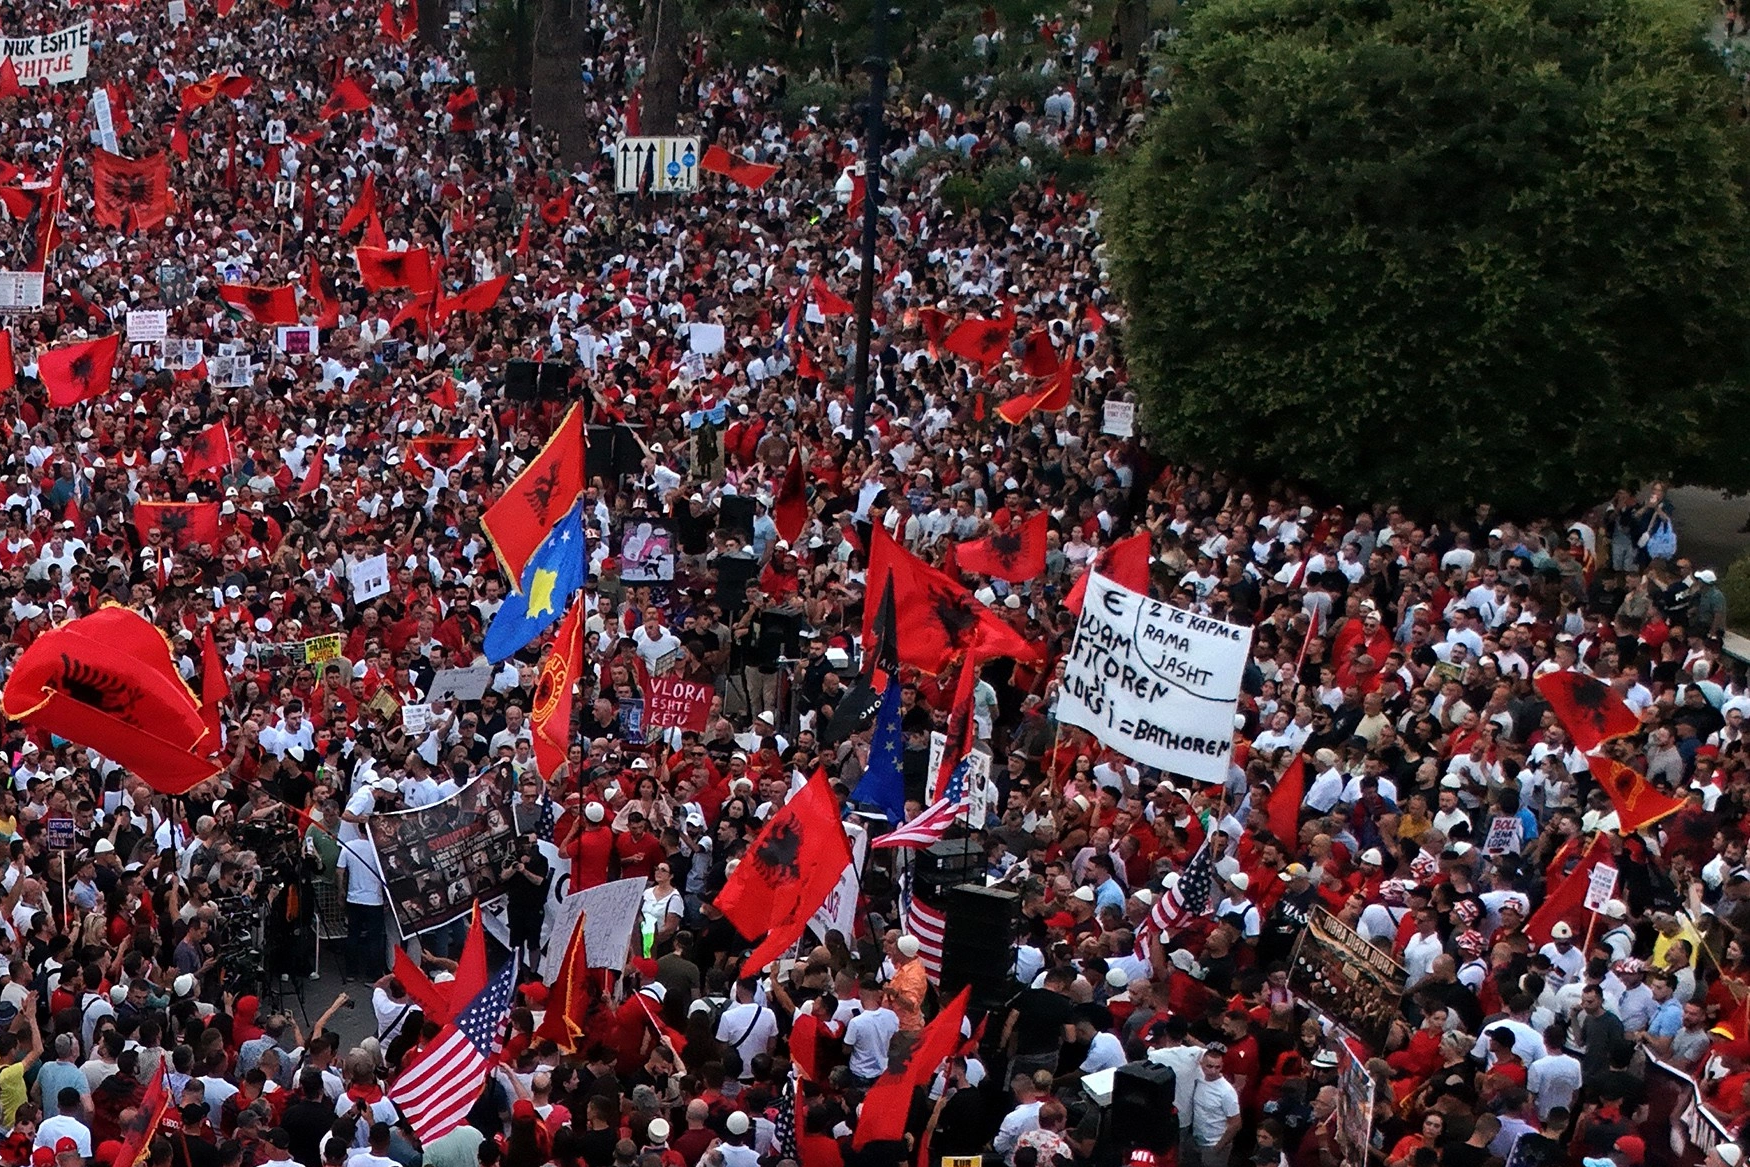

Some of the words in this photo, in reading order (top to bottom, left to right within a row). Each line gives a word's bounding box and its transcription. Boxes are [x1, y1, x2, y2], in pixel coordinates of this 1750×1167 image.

[3, 39, 35, 56] NUK
[13, 54, 74, 78] SHITJE
[1149, 602, 1163, 618] 2
[1143, 623, 1190, 653] RAMA
[650, 678, 706, 704] VLORA
[1323, 915, 1346, 943] DIBRA
[1346, 931, 1369, 960] DIBRA
[1369, 949, 1396, 976] DIBRA
[953, 1159, 972, 1167] KUR
